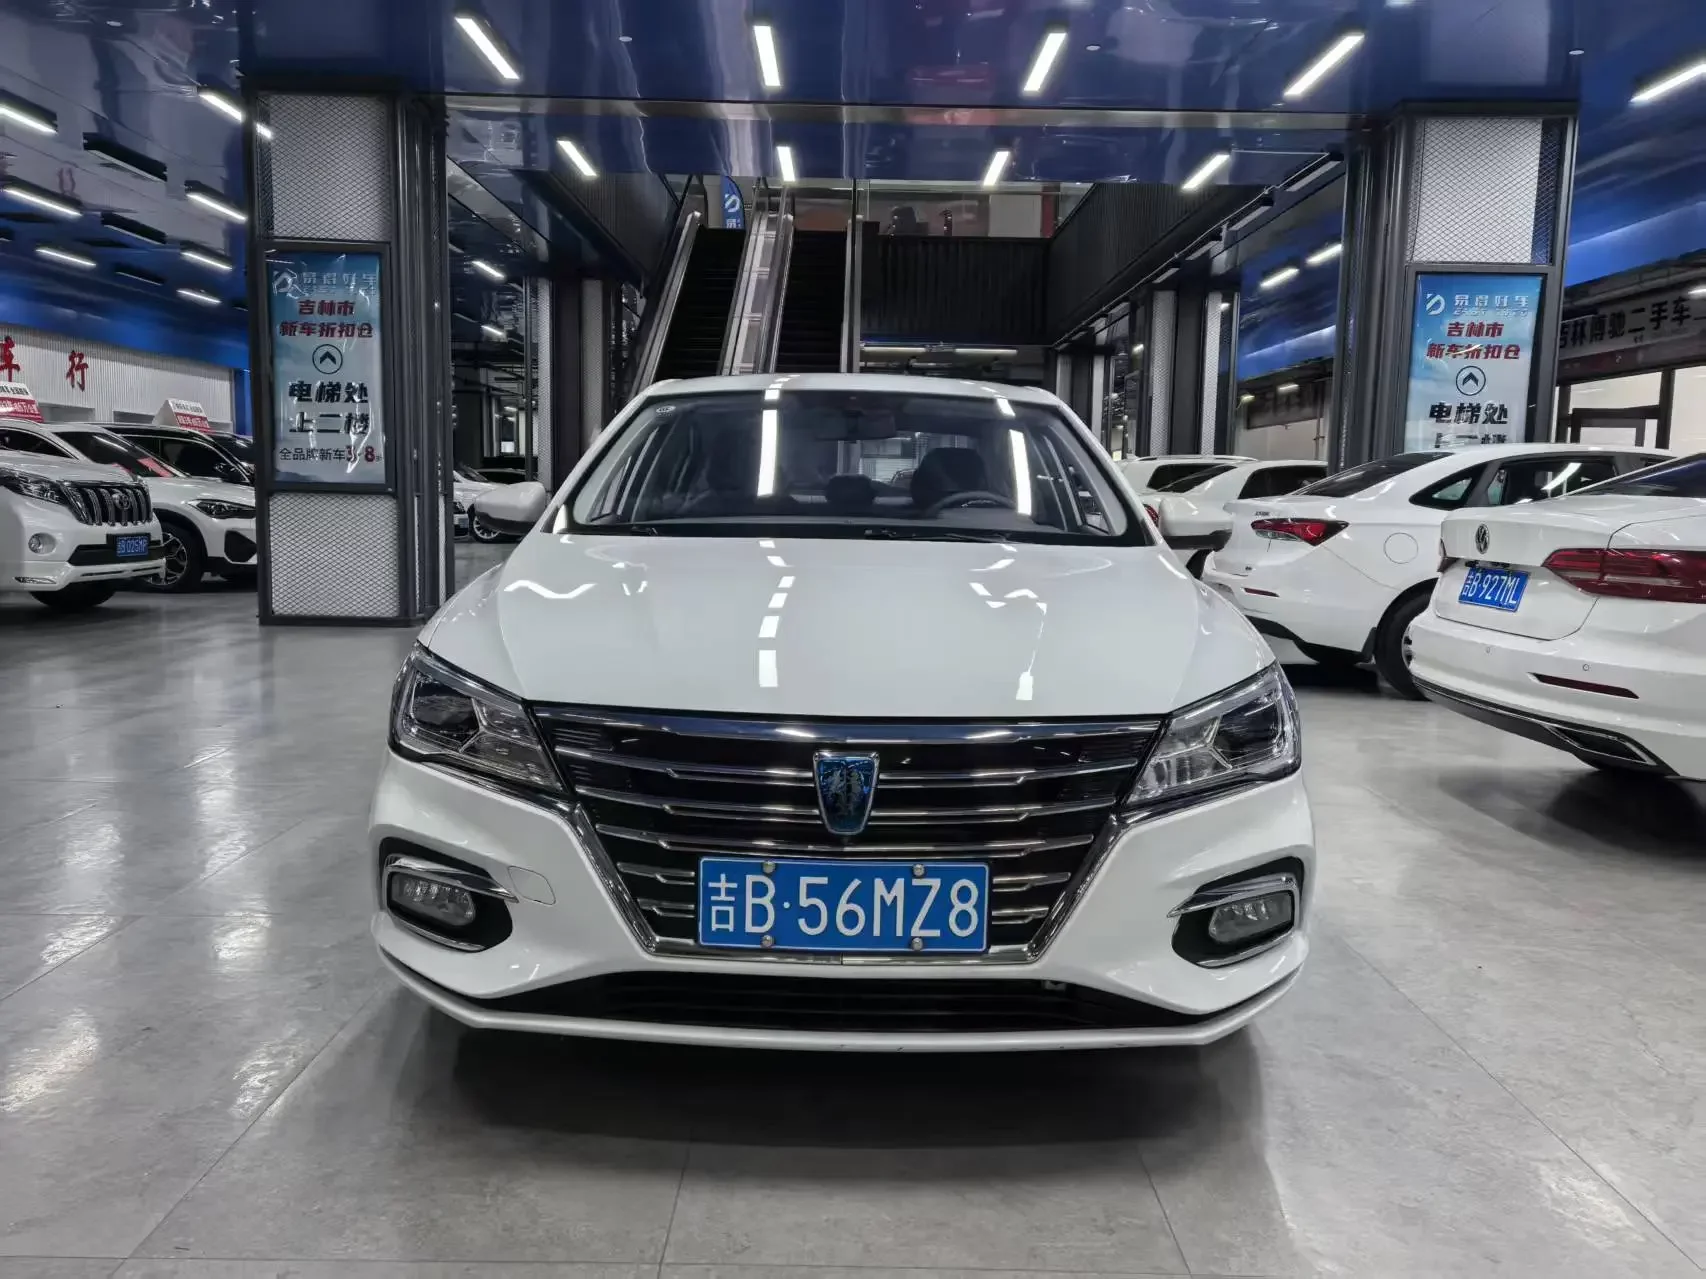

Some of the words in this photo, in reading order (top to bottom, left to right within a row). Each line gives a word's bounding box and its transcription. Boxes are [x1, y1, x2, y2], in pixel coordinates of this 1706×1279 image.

[298, 299, 354, 316] 吉林市
[280, 320, 373, 338] 新车折扣仓
[1447, 321, 1504, 337] 吉林市
[1559, 296, 1706, 349] 吉林博驰二手车
[1426, 342, 1520, 360] 新车折扣仓
[289, 380, 369, 403] 电梯处
[289, 412, 370, 434] 上二楼
[1429, 402, 1508, 424] 电梯处
[708, 873, 979, 938] 吉B·56MZ8
